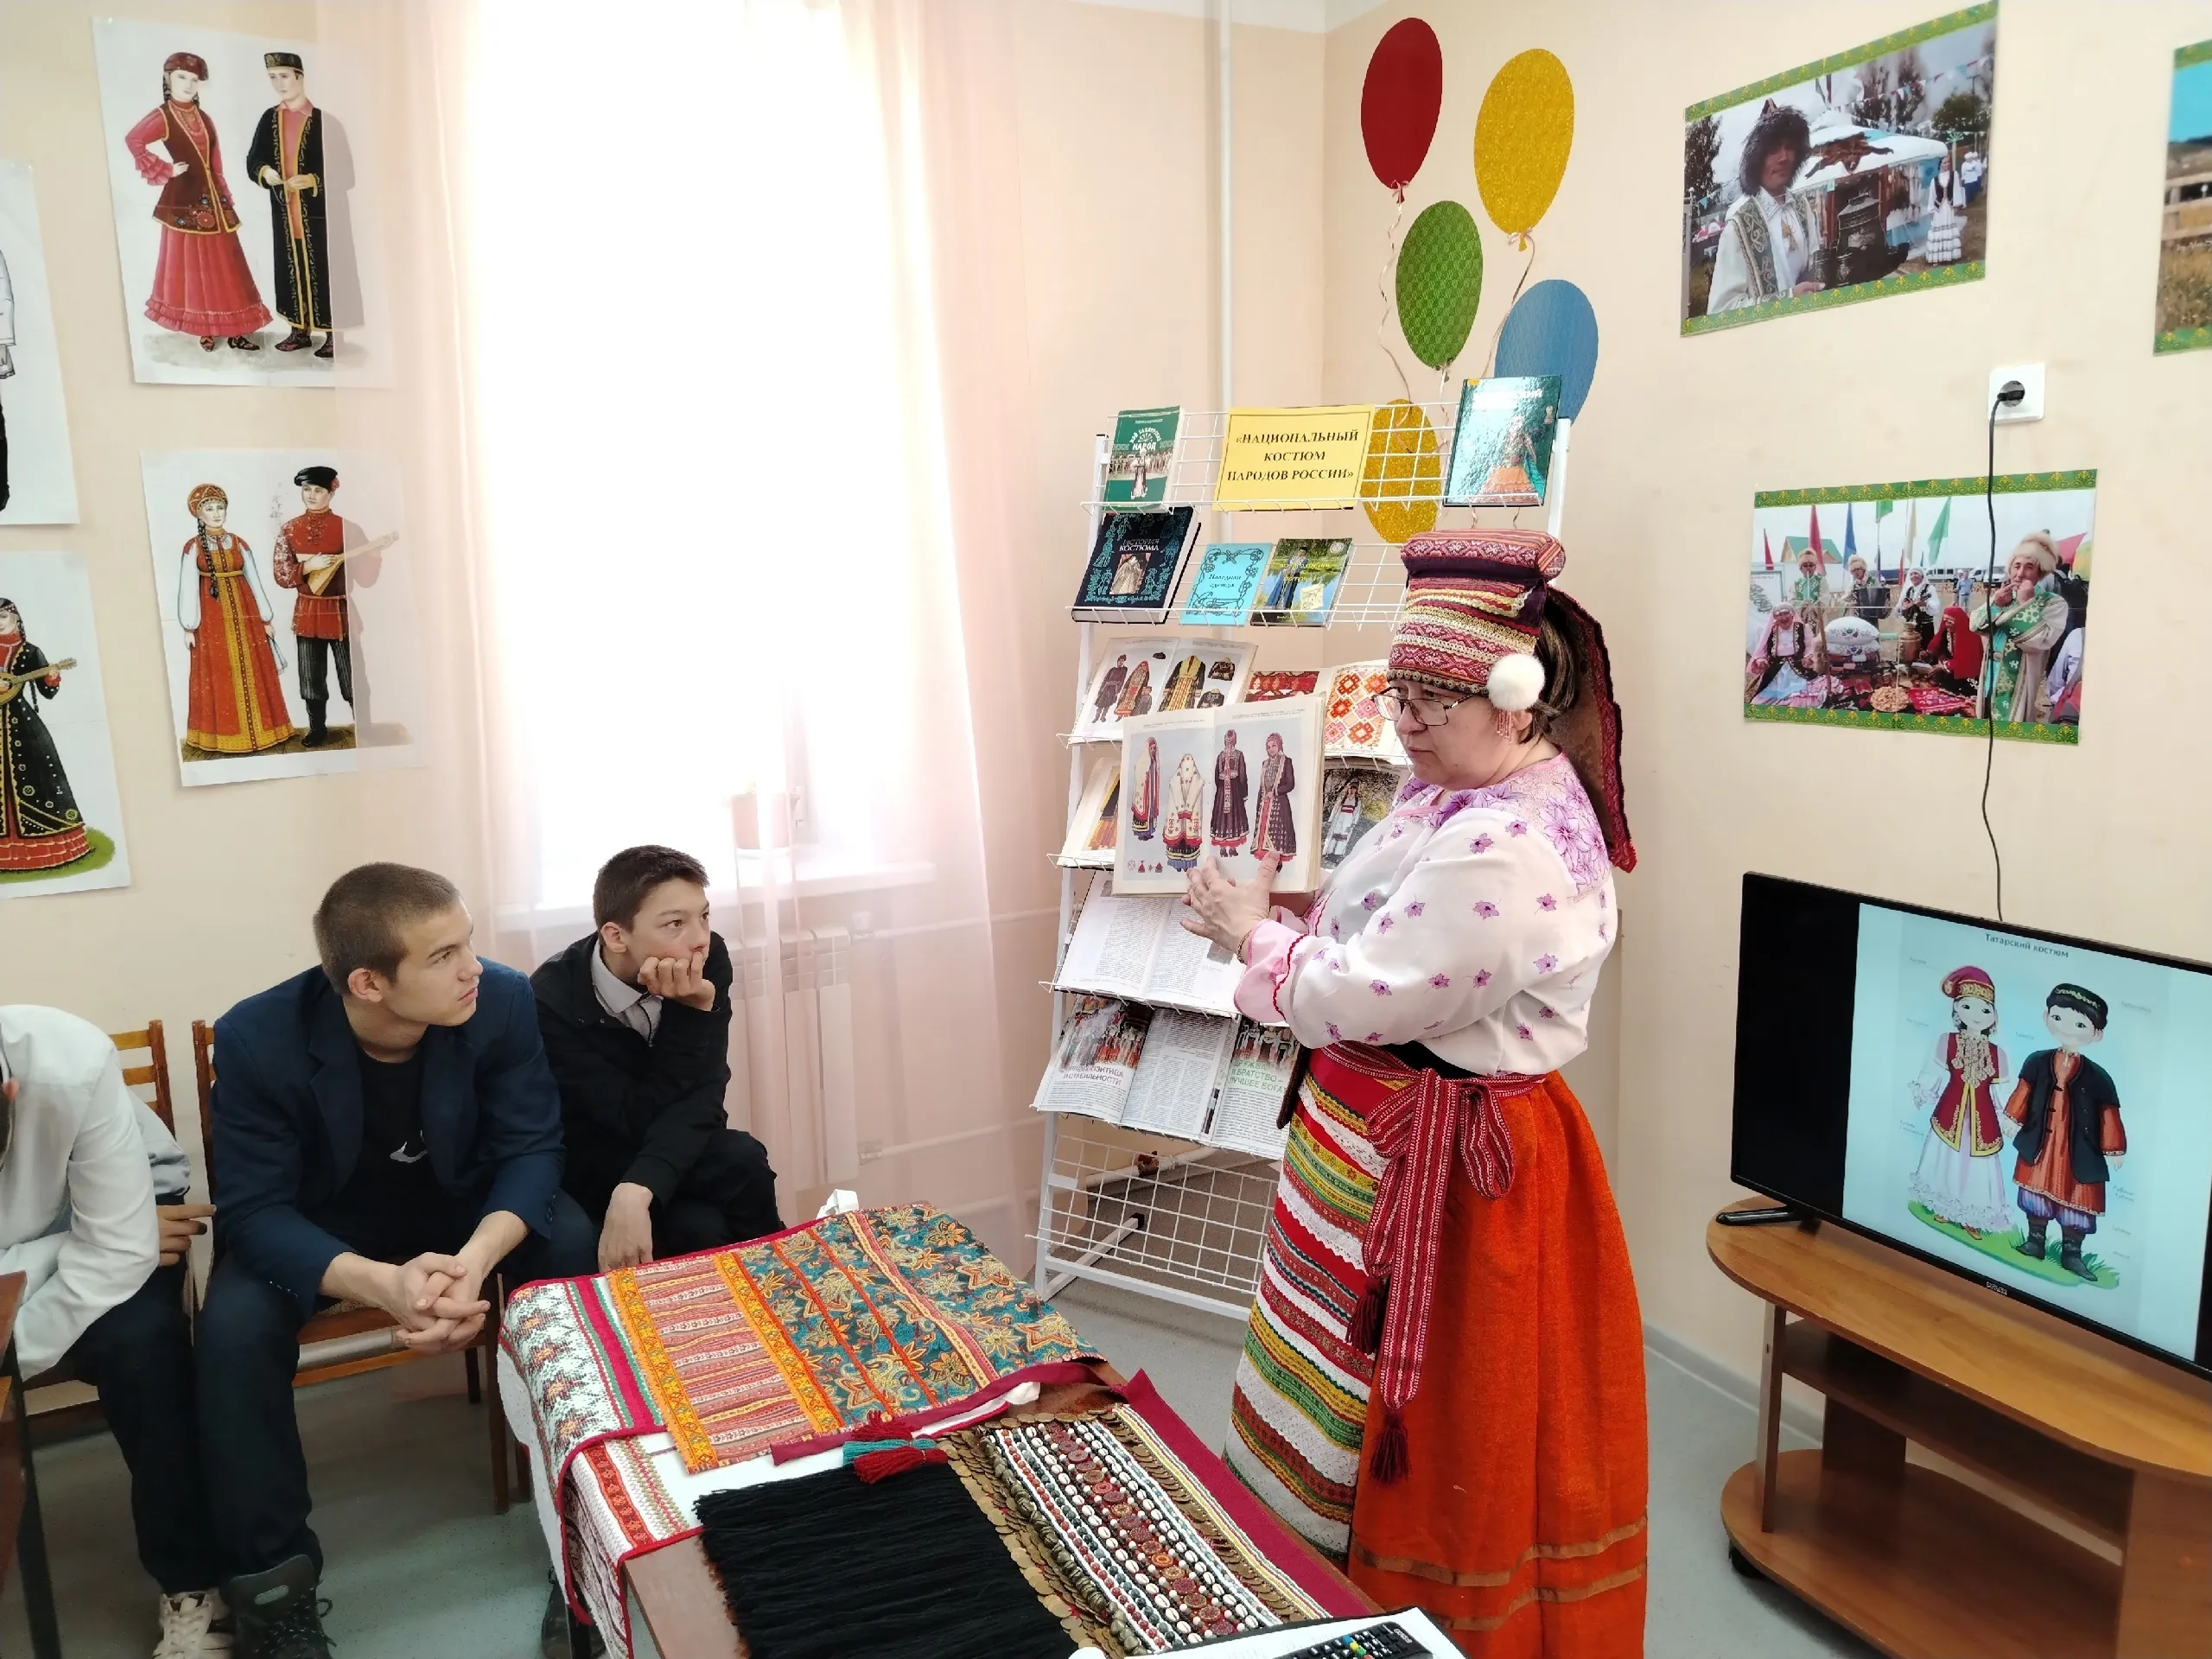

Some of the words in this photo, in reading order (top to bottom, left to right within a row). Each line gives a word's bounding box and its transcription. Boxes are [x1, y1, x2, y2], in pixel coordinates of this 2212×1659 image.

[1236, 429, 1358, 445] «НАЦИОНАЛЬНЫЙ
[1132, 442, 1157, 450] НАРОД
[1264, 451, 1325, 461] КОСТЮМ
[1227, 470, 1288, 483] НАРОДОВ
[1292, 469, 1354, 480] РОССИИ»
[1985, 933, 2031, 950] Татарский
[2033, 944, 2069, 957] костюм
[1234, 1059, 1267, 1071] ДРУЖБА
[1069, 1072, 1122, 1086] СТАБИЛЬНОСТИ
[1236, 1068, 1277, 1083] БРАТСТВО
[1228, 1077, 1261, 1089] ЛУЧШЕЕ
